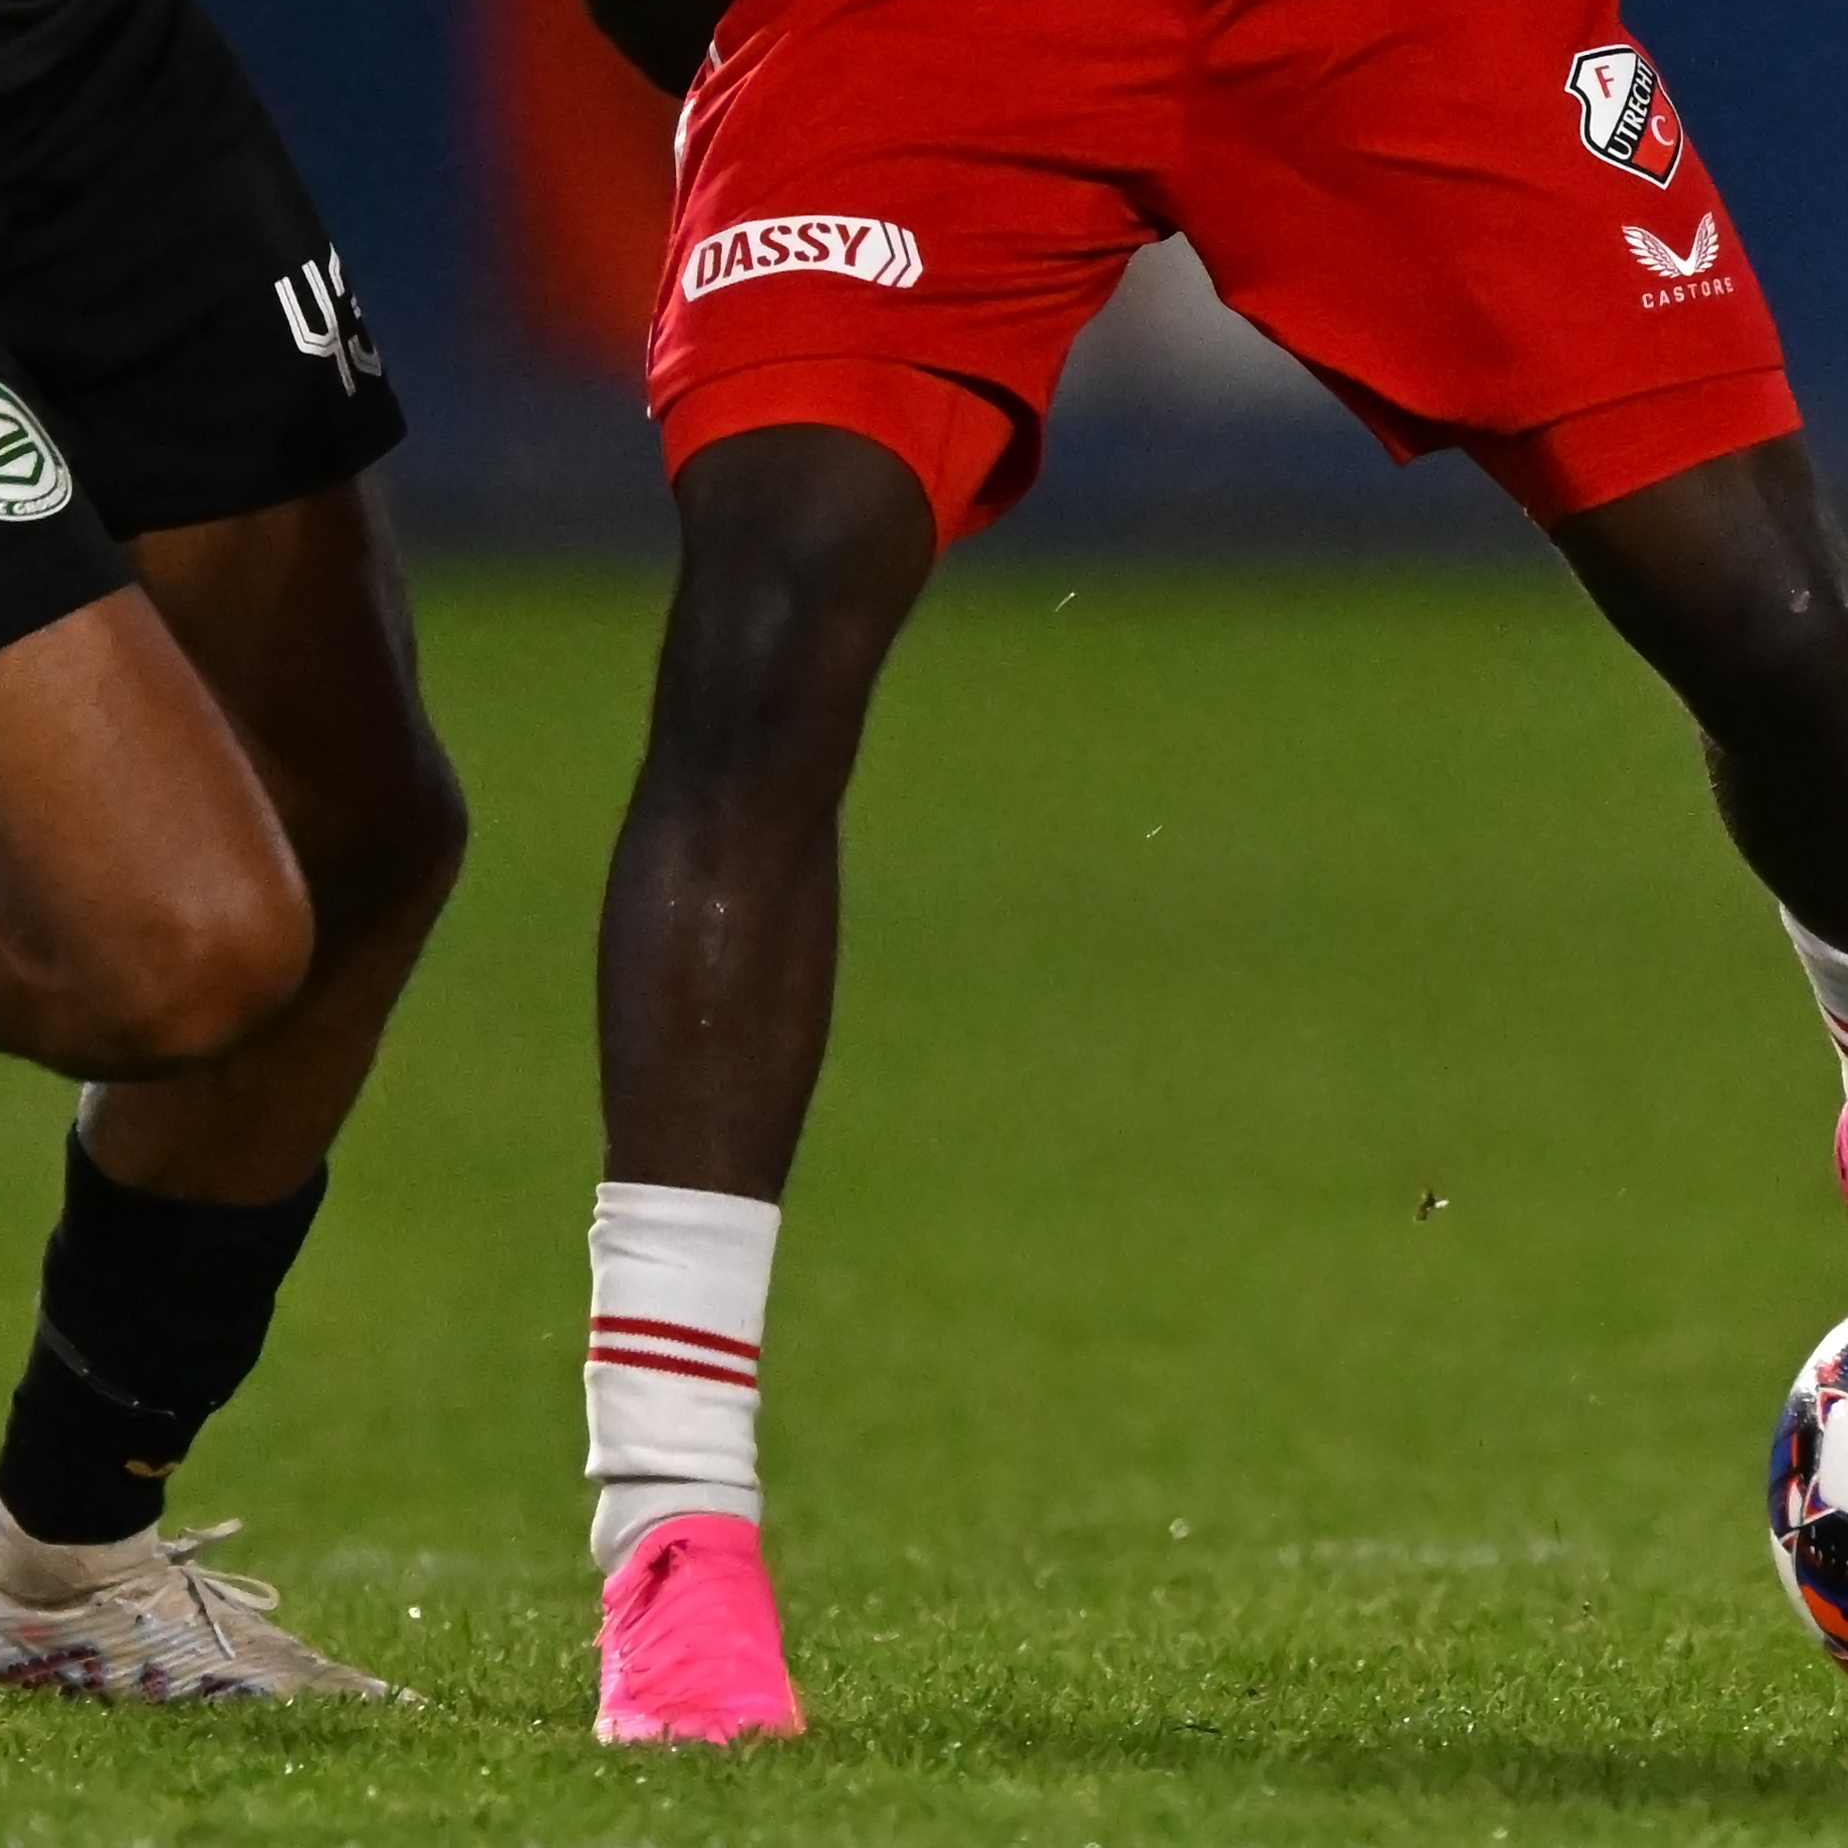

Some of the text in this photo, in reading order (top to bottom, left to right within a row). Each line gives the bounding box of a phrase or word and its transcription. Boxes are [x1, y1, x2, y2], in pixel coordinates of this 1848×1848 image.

[1594, 64, 1615, 99] F
[1607, 58, 1655, 161] UTRECHT
[1651, 115, 1674, 146] C
[695, 222, 873, 290] DASSY
[1642, 276, 1735, 309] CASTORE
